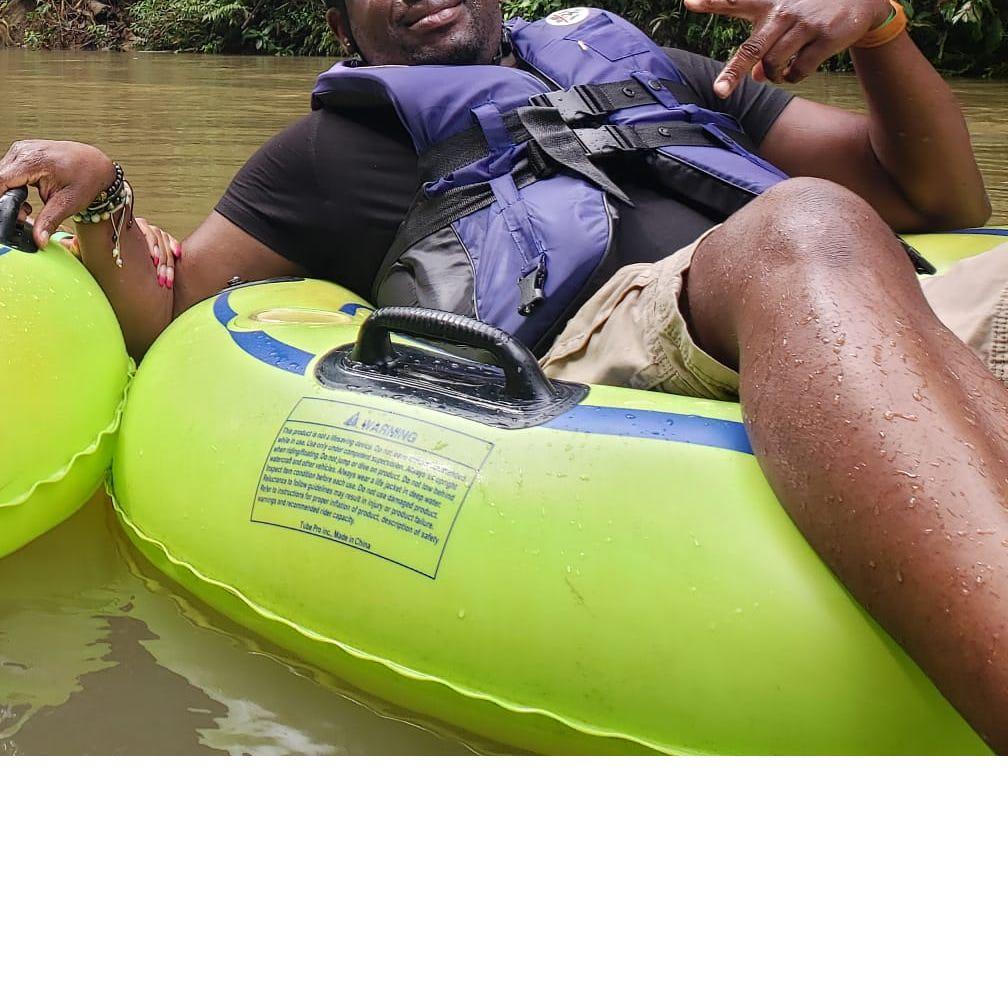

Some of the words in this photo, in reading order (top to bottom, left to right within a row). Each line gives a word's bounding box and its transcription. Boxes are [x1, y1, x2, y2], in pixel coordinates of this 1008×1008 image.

[362, 422, 417, 443] WARNING
[317, 443, 328, 451] only
[338, 468, 356, 479] Always
[357, 474, 370, 482] wear
[383, 483, 402, 493] jacket
[409, 491, 424, 501] deep
[411, 480, 422, 488] not
[333, 490, 344, 499] may
[345, 493, 361, 502] result
[368, 500, 383, 511] injury
[391, 509, 414, 521] product
[366, 488, 376, 496] not
[388, 495, 414, 509] damaged
[312, 496, 329, 504] proper
[382, 517, 413, 533] description
[421, 532, 439, 545] safety
[300, 521, 312, 530] Tube
[313, 524, 322, 533] Pro
[334, 531, 348, 541] Made
[355, 538, 371, 549] China
